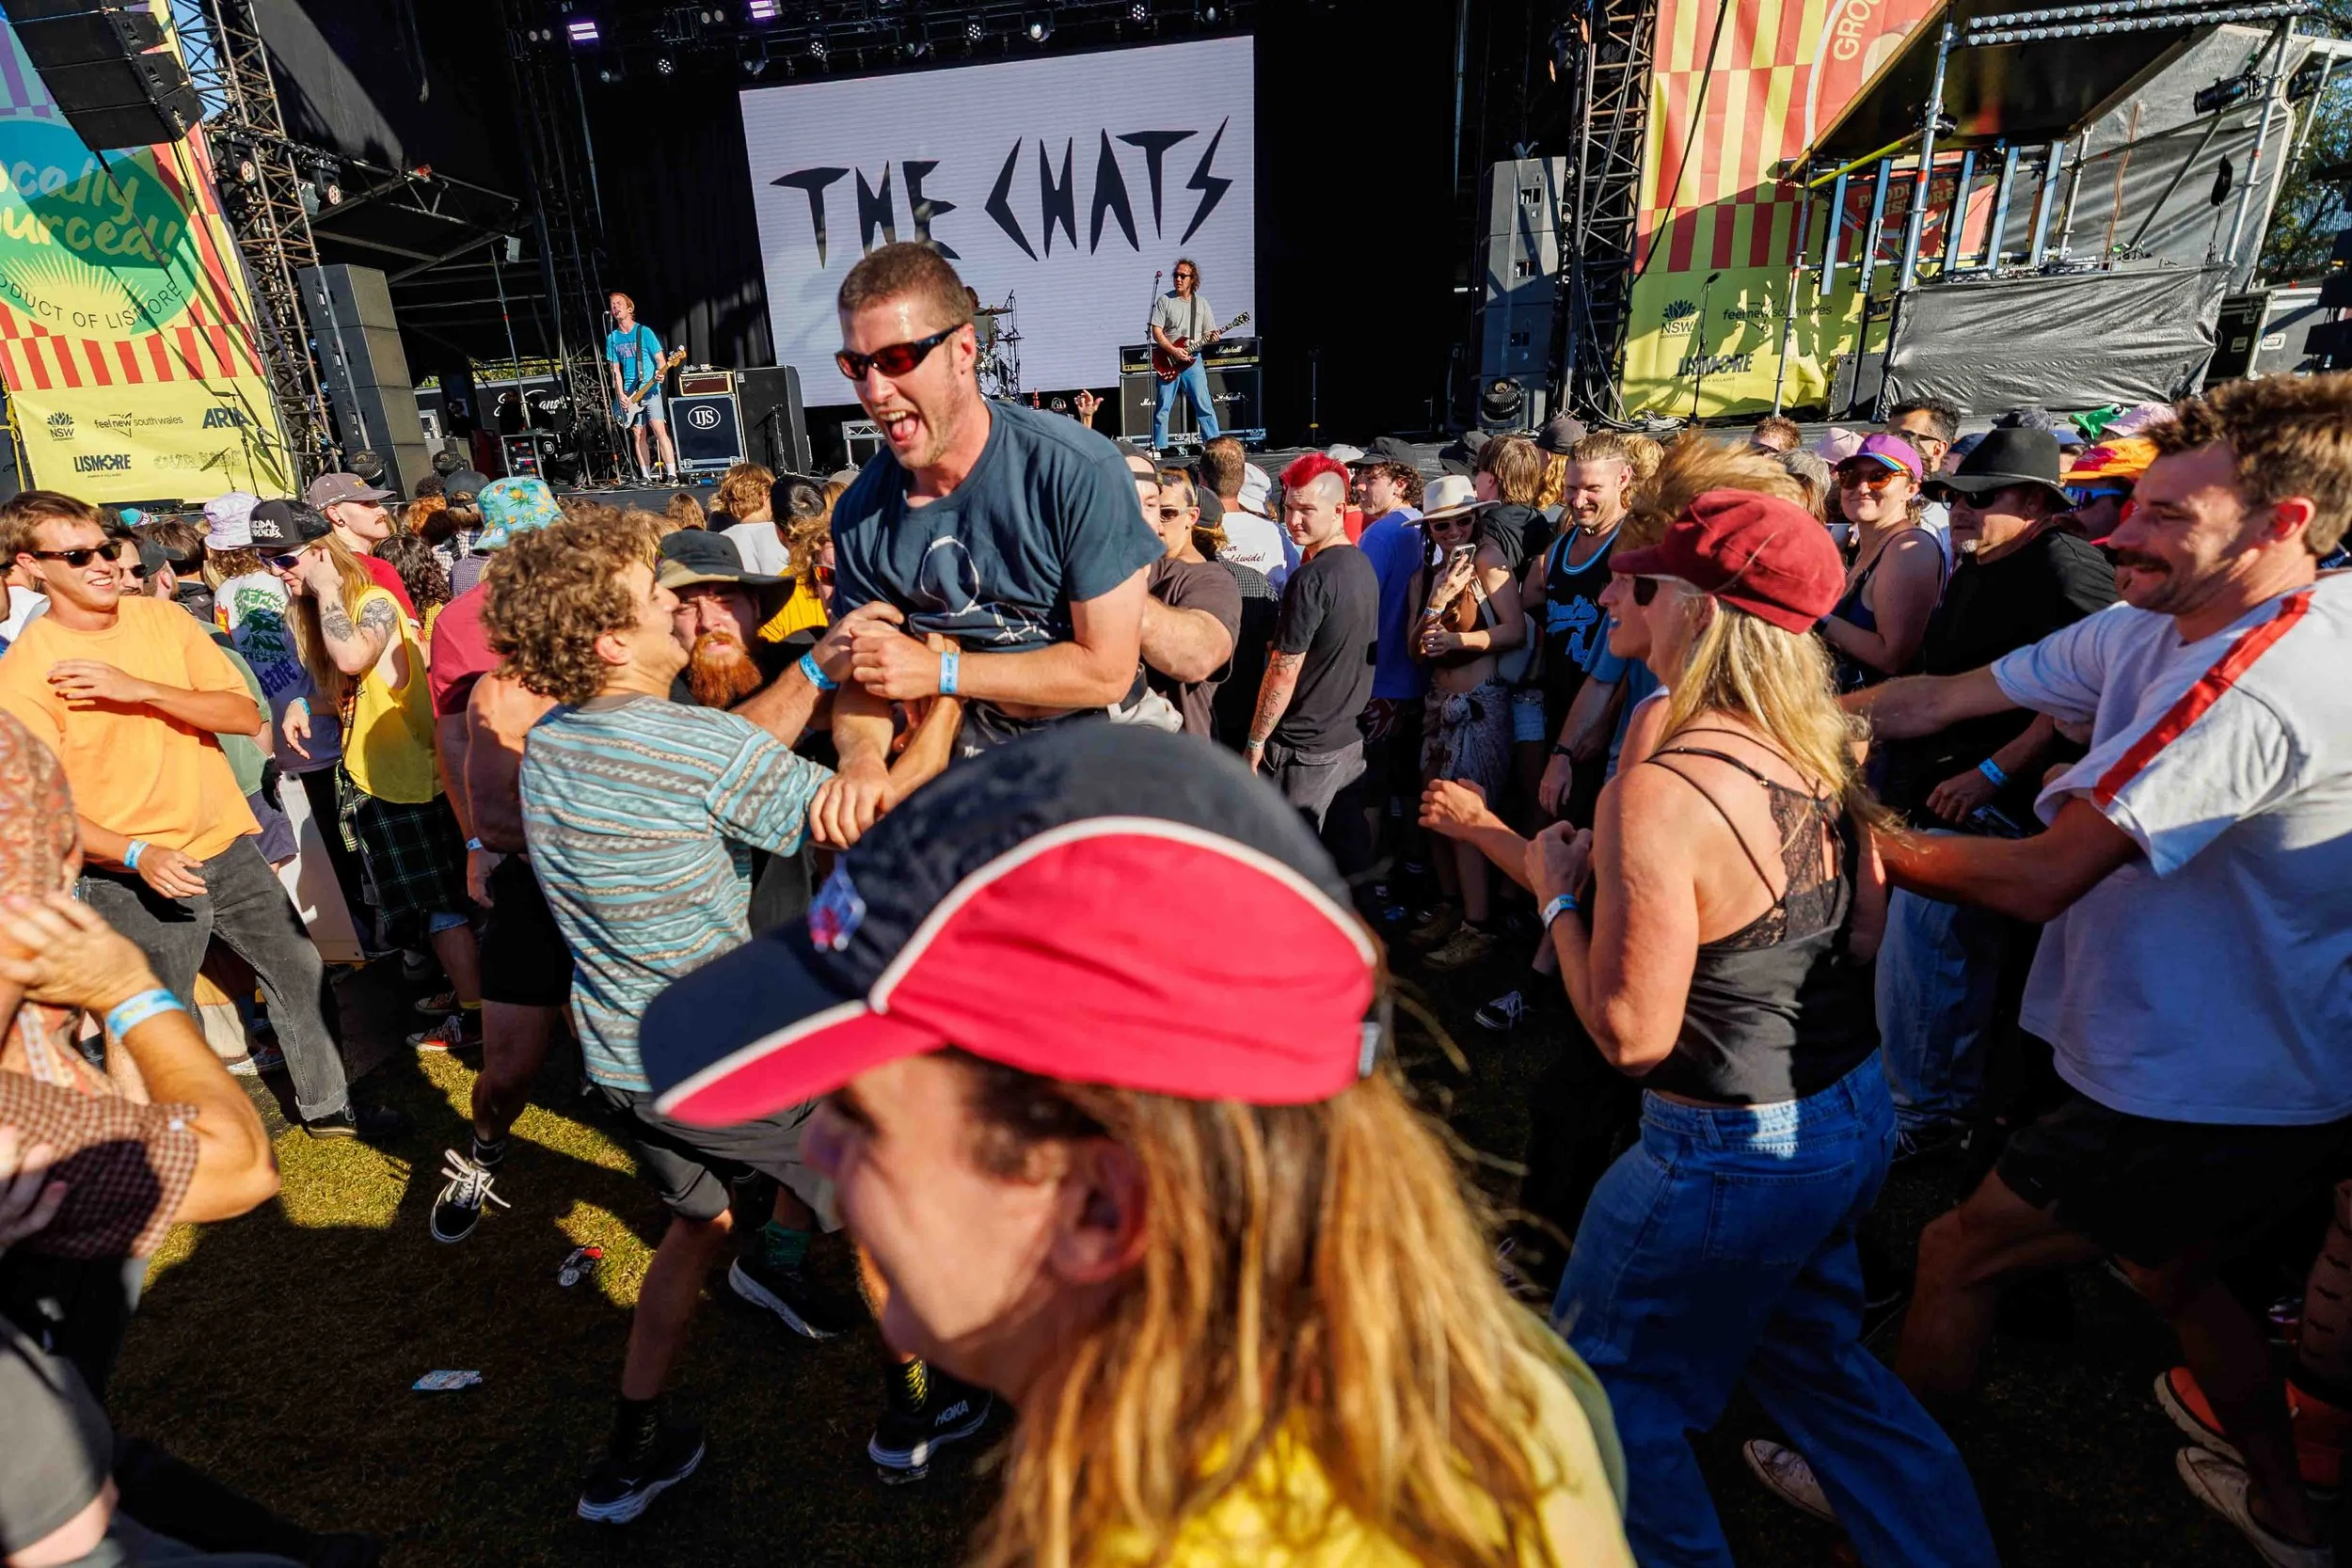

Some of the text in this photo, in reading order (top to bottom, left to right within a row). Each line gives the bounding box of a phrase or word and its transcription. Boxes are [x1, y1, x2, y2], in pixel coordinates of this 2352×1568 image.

[1834, 0, 1881, 60] GRO
[770, 115, 1233, 270] THE CHATS
[0, 206, 179, 263] urced!
[72, 311, 99, 328] OF
[105, 281, 183, 329] LISMORE
[1723, 309, 1746, 320] feel
[1661, 321, 1693, 334] NSW
[94, 416, 183, 429] feel new south wales
[202, 406, 254, 429] ARIA
[695, 410, 714, 426] IJS
[50, 428, 74, 438] NSW
[73, 454, 132, 472] LISMORE
[934, 1400, 970, 1427] HOKA
